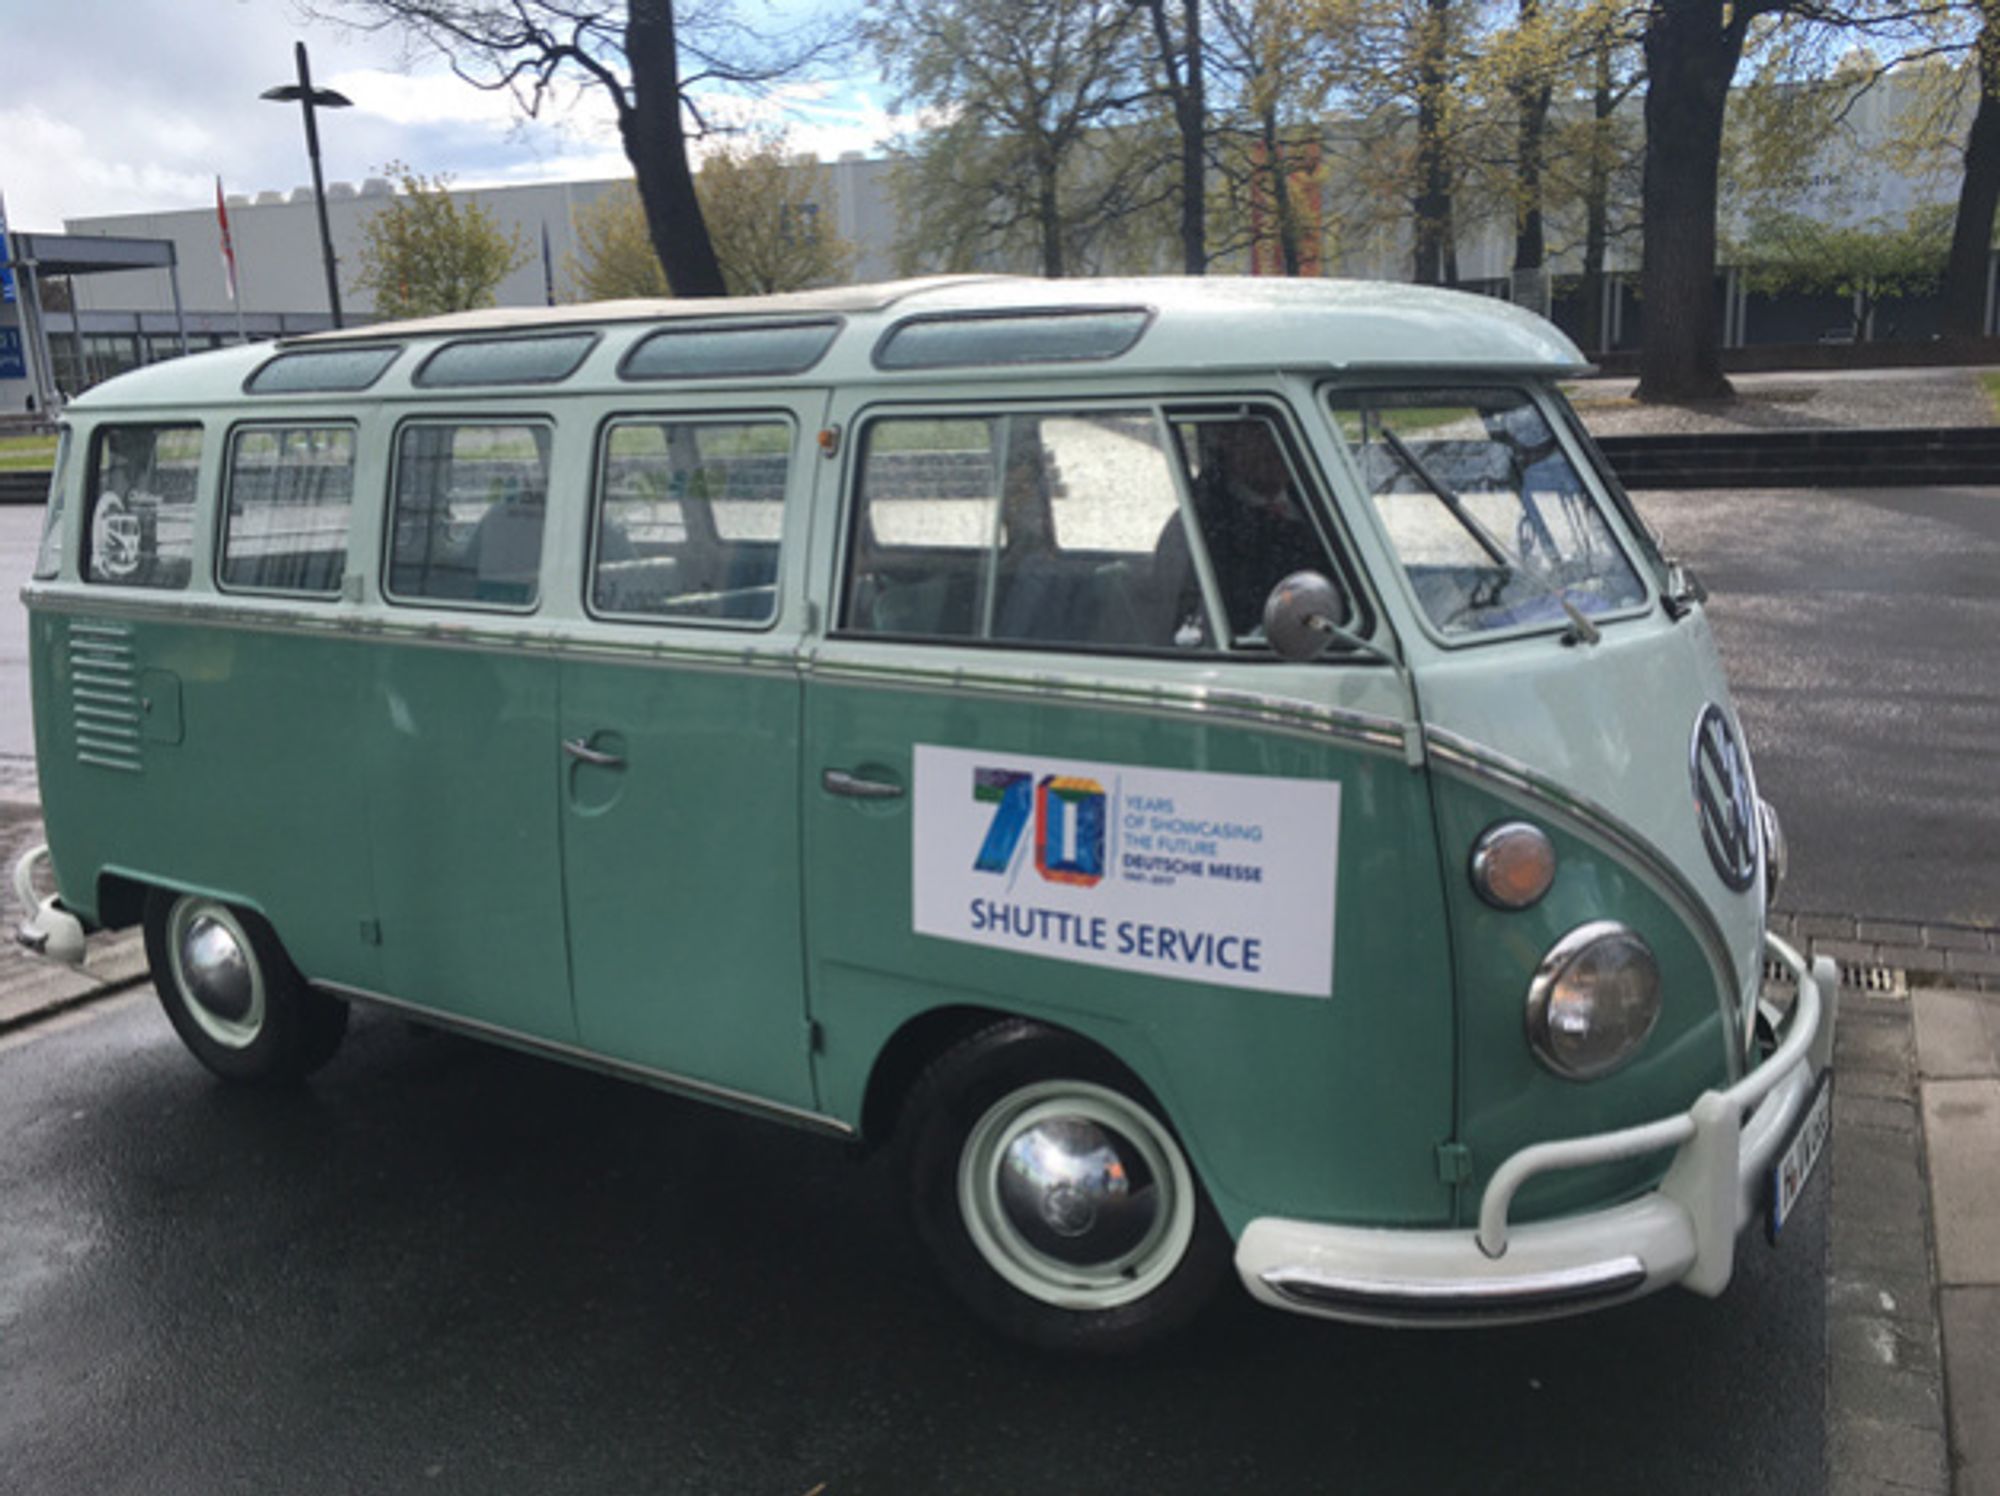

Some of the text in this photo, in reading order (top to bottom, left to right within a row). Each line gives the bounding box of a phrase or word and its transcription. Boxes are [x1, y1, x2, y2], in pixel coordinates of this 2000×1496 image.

[1125, 796, 1174, 814] YEARS
[972, 766, 1106, 888] 70
[1124, 814, 1263, 842] OF SHOWCASING
[1124, 832, 1217, 857] THE FUTURE
[1123, 853, 1263, 883] DEUTSCHE MESSE
[971, 898, 1262, 973] SHUTTLE SERVICE
